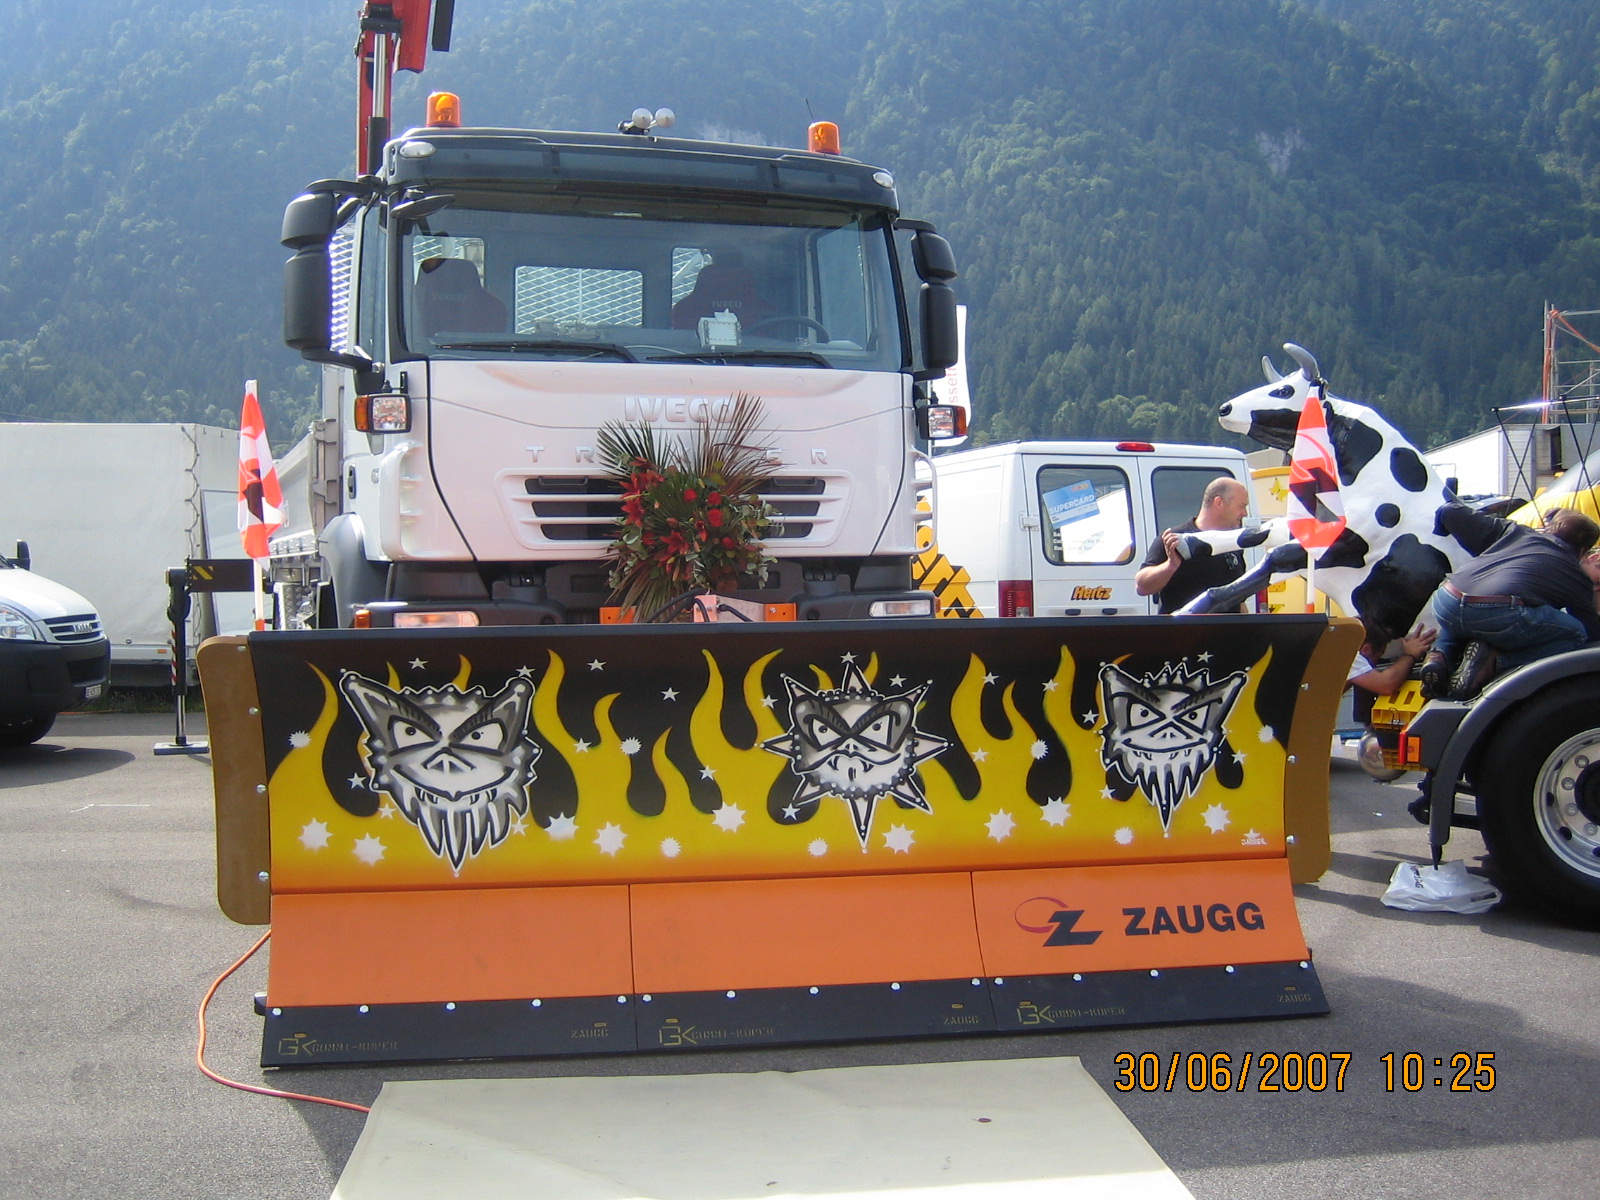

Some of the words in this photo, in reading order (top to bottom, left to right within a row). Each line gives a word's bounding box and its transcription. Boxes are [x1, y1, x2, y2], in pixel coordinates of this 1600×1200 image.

[624, 397, 737, 423] IVECO
[1050, 494, 1095, 515] SUPERCARD
[1071, 585, 1112, 601] Hertz
[1122, 902, 1266, 937] ZAUGG
